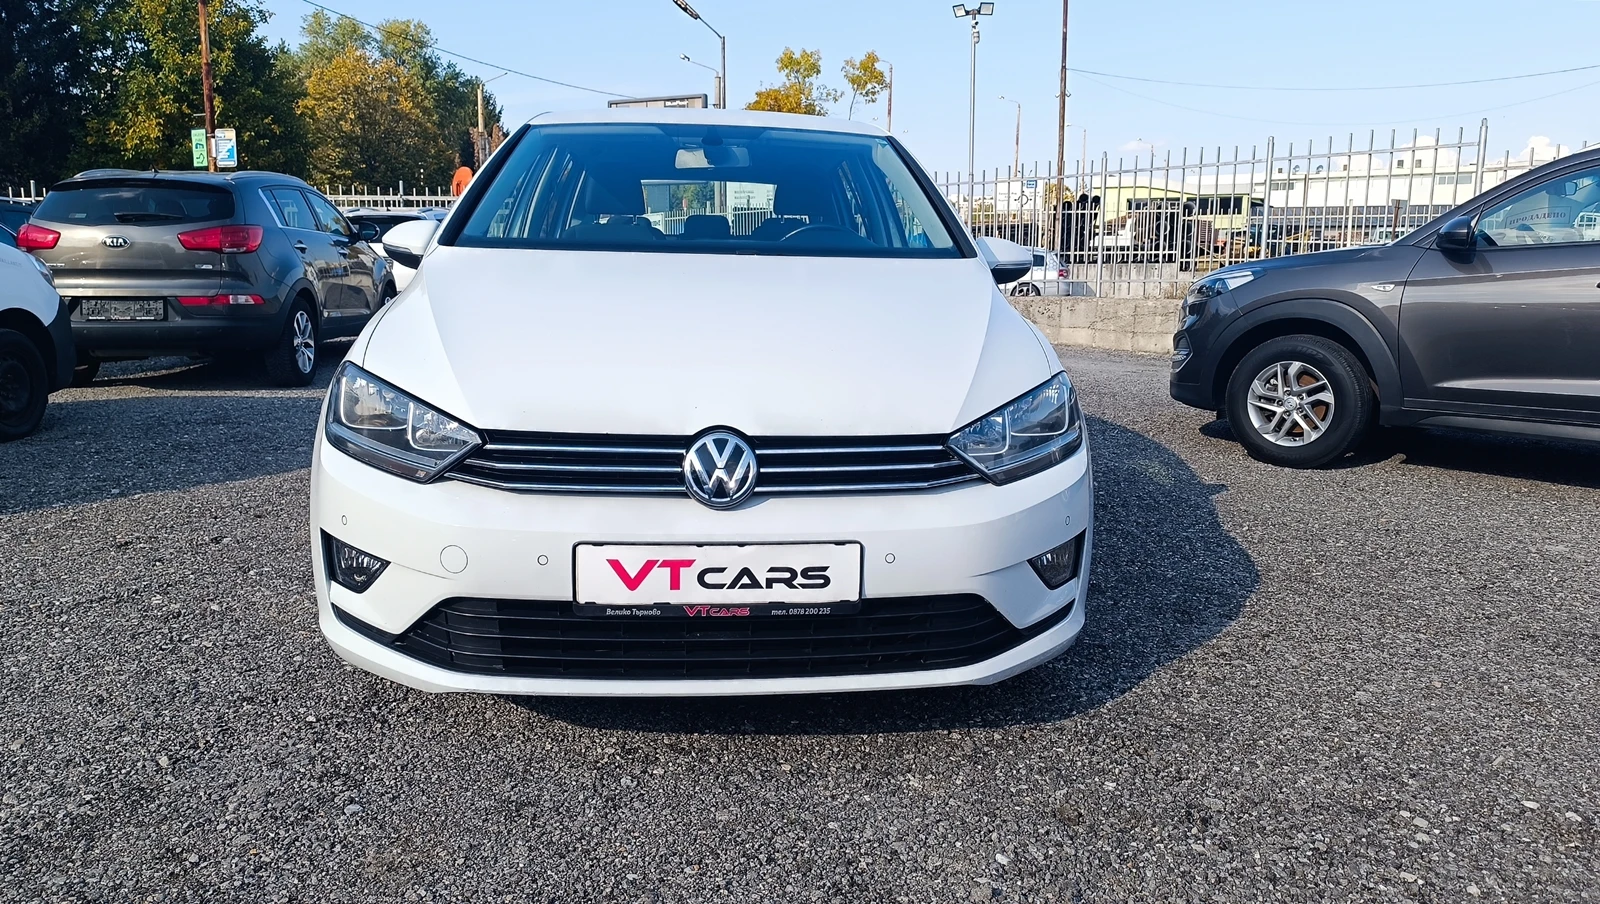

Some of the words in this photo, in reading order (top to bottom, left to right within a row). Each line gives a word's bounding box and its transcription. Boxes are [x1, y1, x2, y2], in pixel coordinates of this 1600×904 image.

[104, 237, 125, 246] KIA
[606, 608, 631, 616] Велико
[632, 608, 661, 617] Търново
[771, 608, 788, 616] тел.
